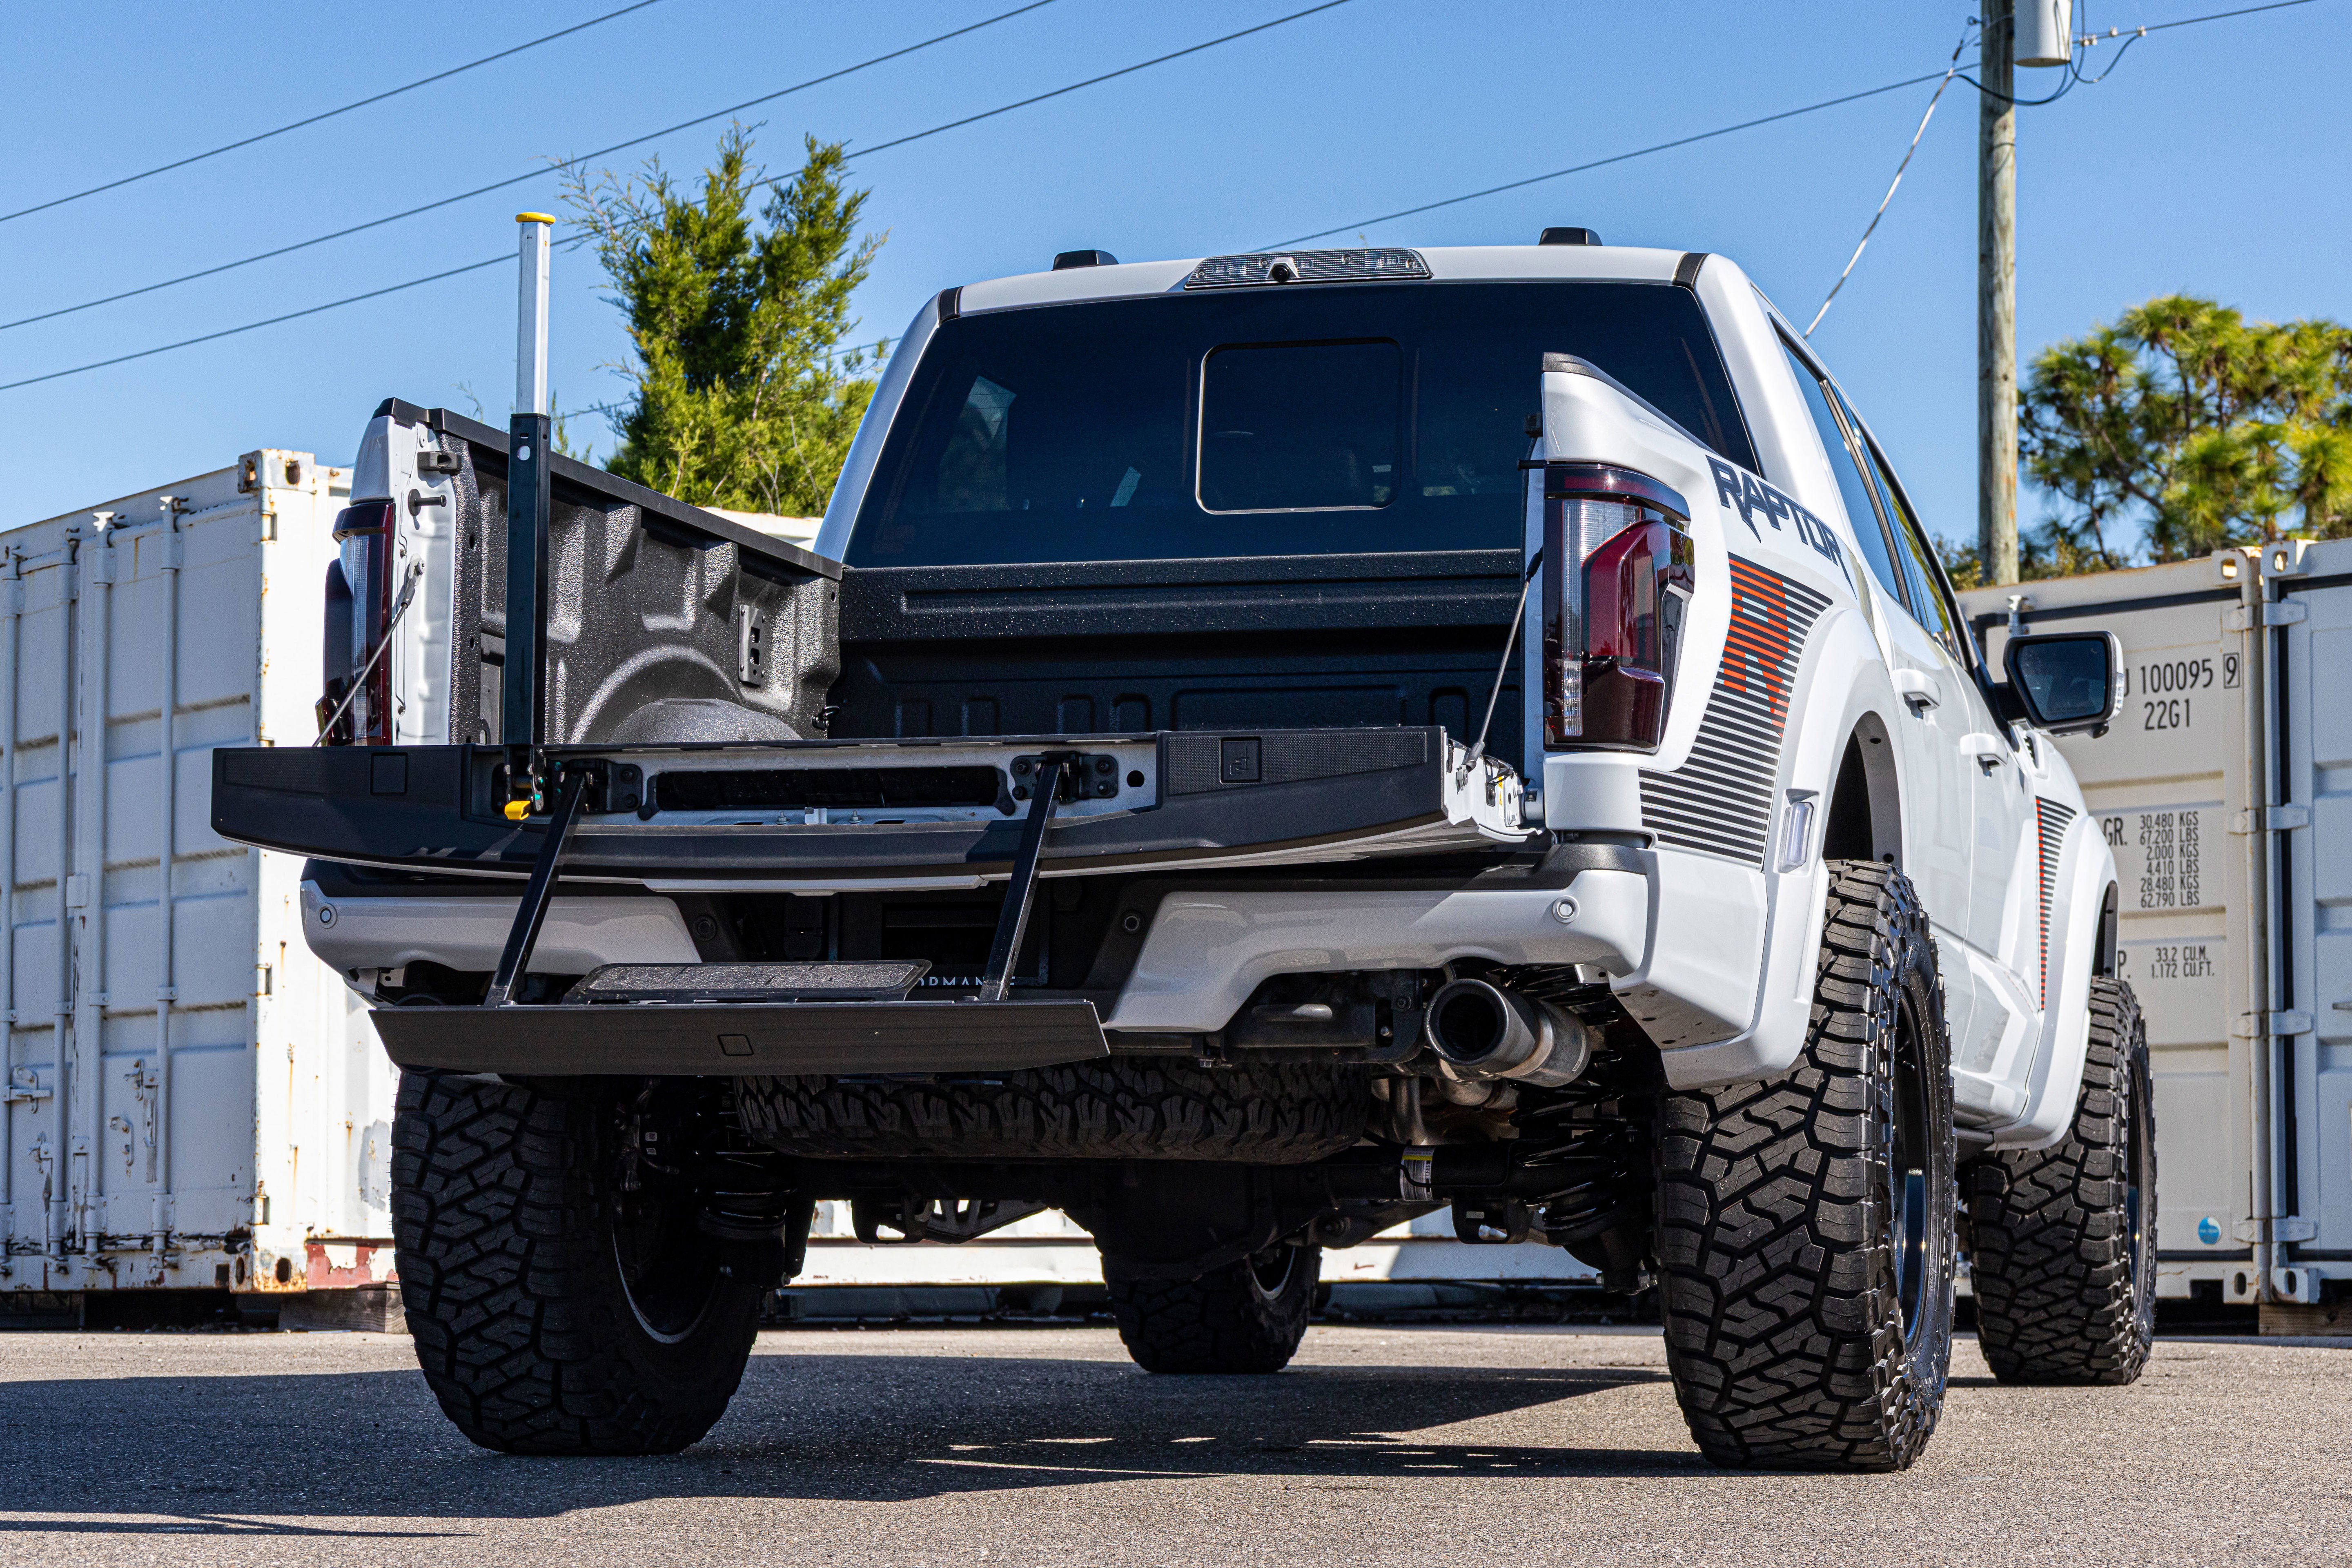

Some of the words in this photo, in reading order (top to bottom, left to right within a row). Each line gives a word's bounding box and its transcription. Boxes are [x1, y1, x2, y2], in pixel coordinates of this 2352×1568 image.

[1705, 454, 1857, 600] RAPTOR
[2140, 658, 2213, 695] 100095
[2226, 656, 2237, 685] 9
[2144, 698, 2190, 731] 22G1
[2140, 813, 2174, 830] 30.480
[2180, 811, 2198, 826] KGS
[2140, 829, 2174, 845] 67.200
[2180, 827, 2198, 842] LBS
[2147, 844, 2174, 860] 2.000
[2180, 843, 2199, 858] KGS
[2147, 860, 2174, 876] 4.410
[2180, 859, 2199, 874] LBS
[2140, 876, 2174, 893] 28.480
[2180, 875, 2199, 890] KGS
[2180, 891, 2200, 906] LBS
[2152, 962, 2177, 979] 1.172
